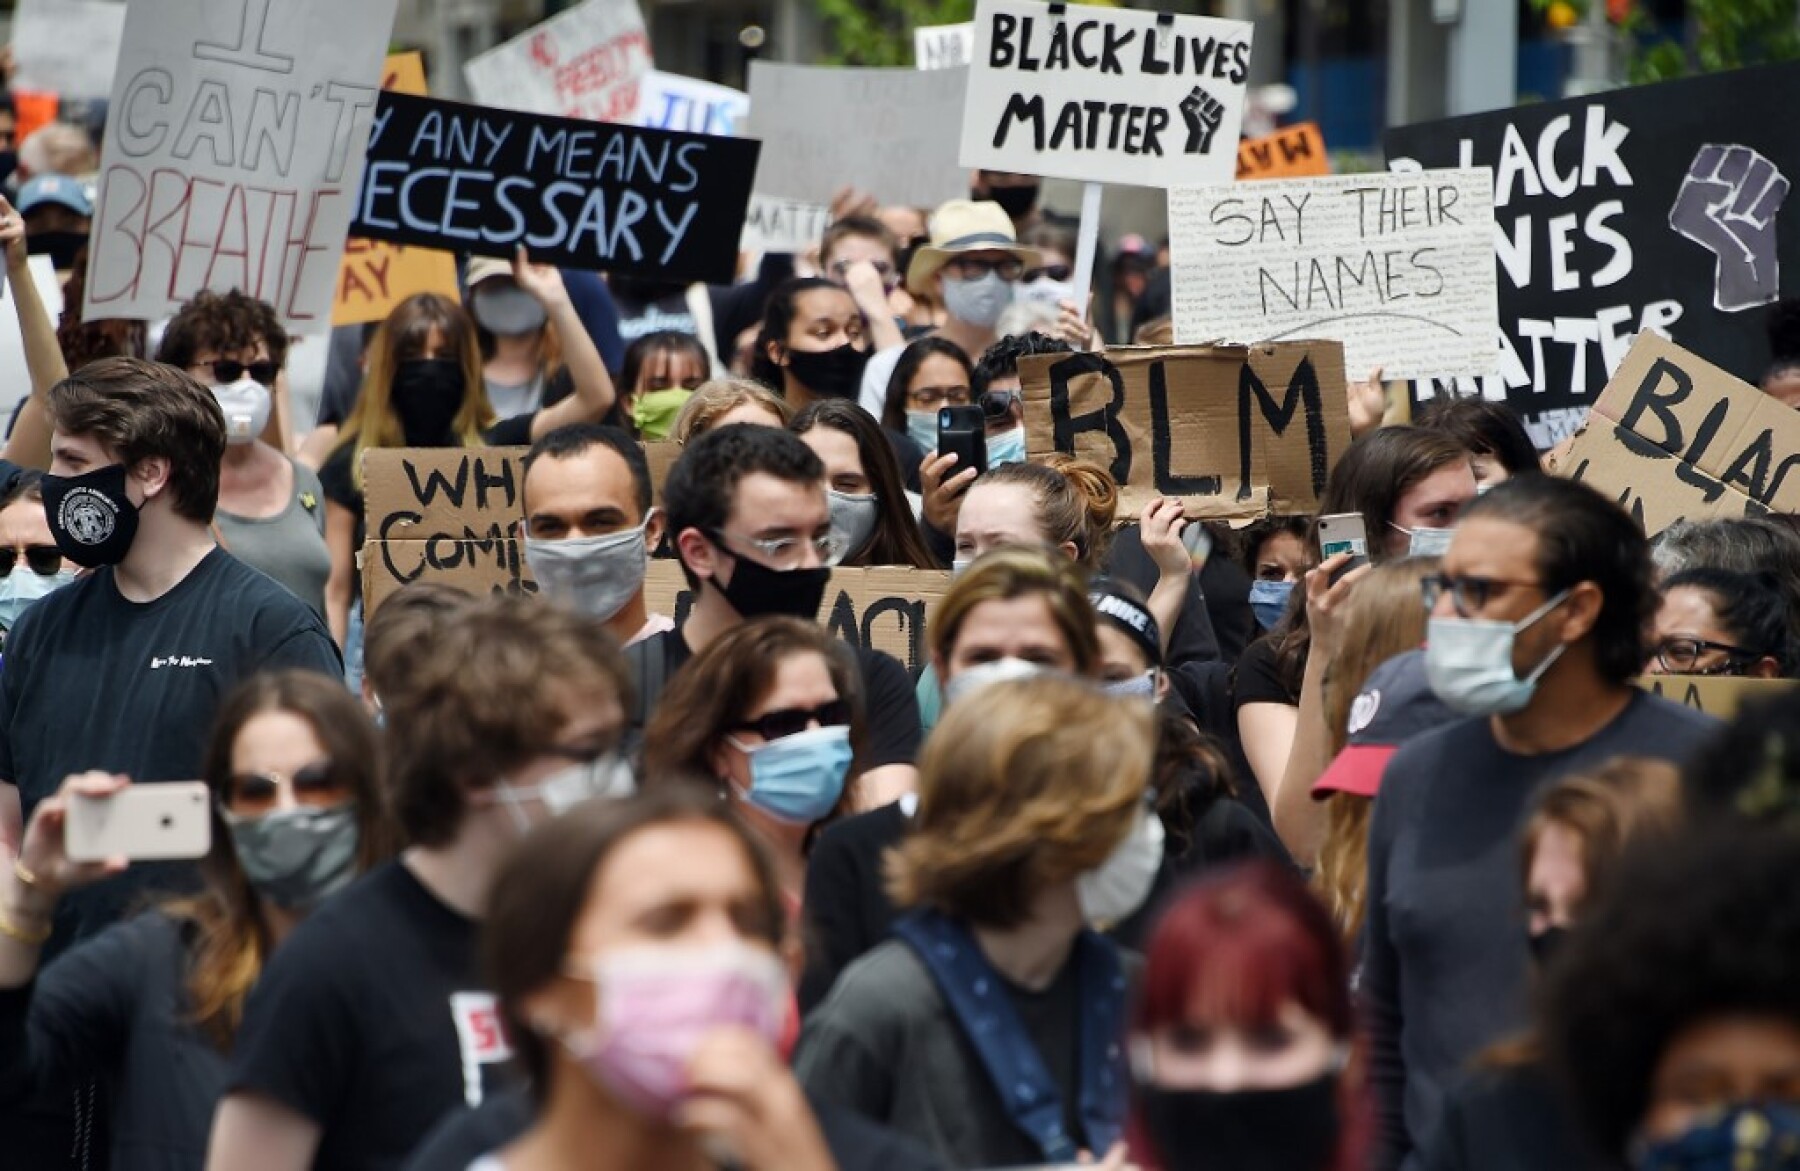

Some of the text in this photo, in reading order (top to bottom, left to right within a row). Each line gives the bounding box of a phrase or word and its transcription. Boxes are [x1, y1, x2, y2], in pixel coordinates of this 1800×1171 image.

[193, 0, 294, 74] I
[989, 13, 1136, 75] BLACK
[1141, 28, 1249, 84] LIVES
[117, 67, 376, 183] CAN'T
[409, 110, 515, 167] ANY
[526, 124, 707, 193] MEANS
[992, 92, 1170, 157] MATTER
[89, 164, 341, 319] BREATHE
[352, 161, 698, 265] ECESSARY
[1210, 185, 1463, 246] SAY THEIR
[1258, 248, 1444, 316] NAMES
[1049, 352, 1328, 502] BLM
